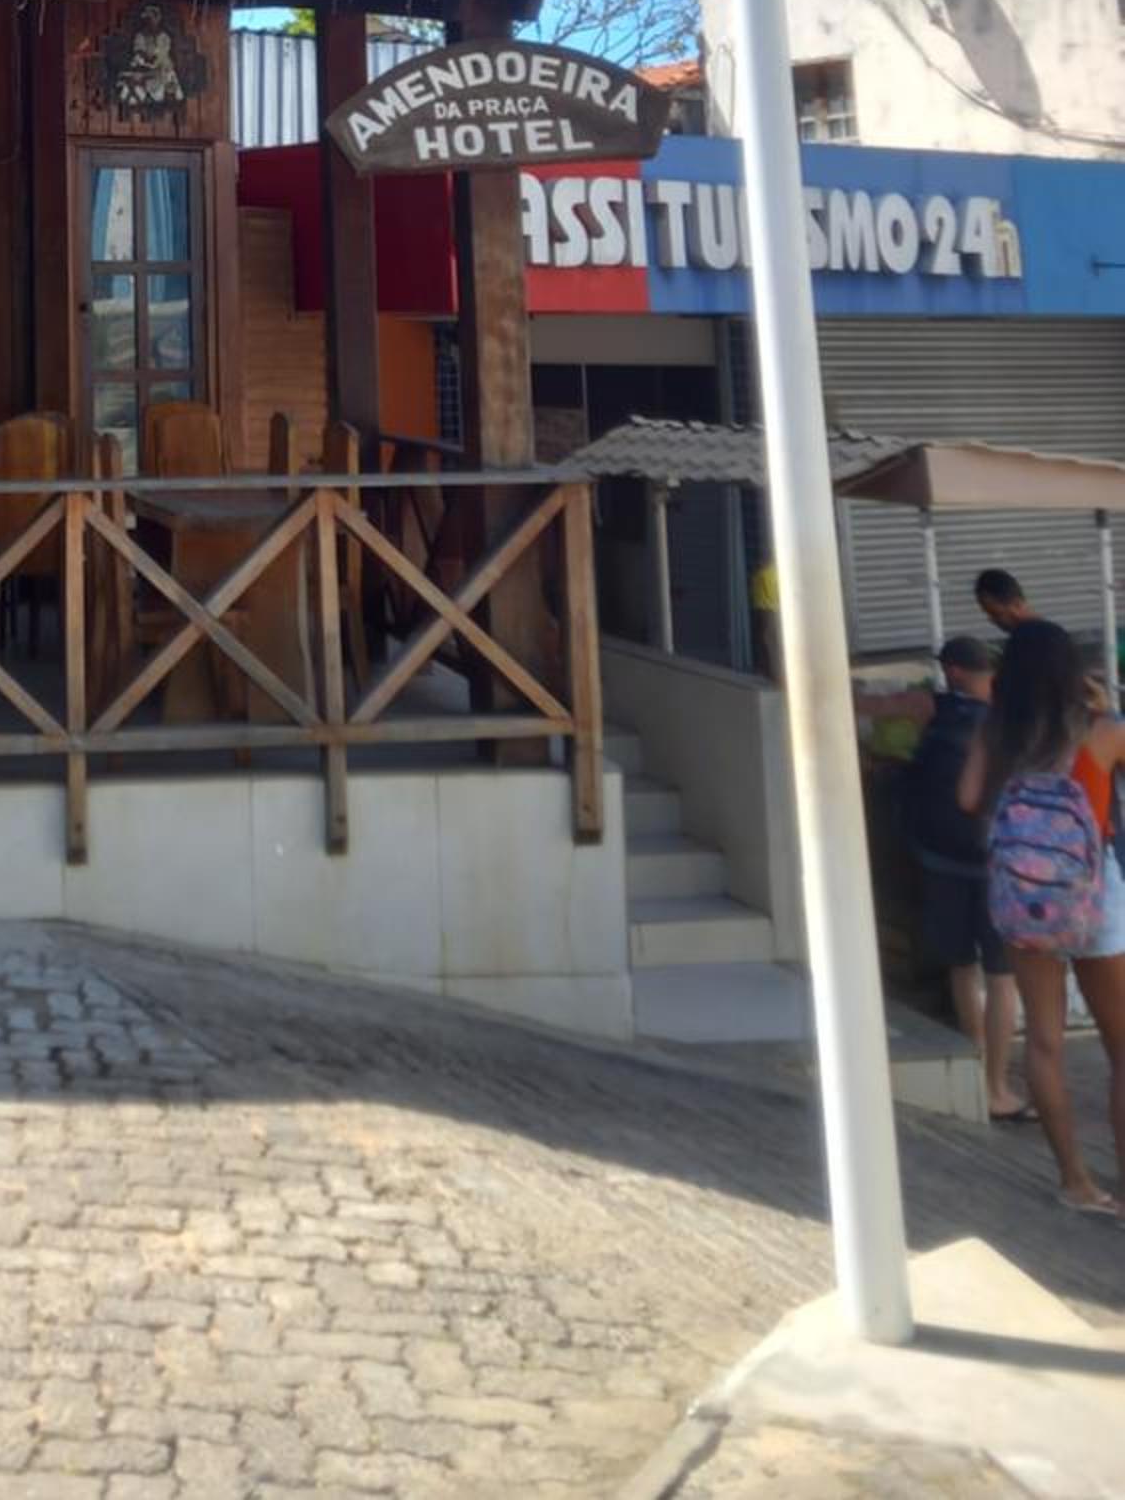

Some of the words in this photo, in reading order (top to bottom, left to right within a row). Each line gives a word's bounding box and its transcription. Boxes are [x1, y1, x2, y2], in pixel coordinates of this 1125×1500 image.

[347, 51, 638, 151] AMENDOEIRA
[434, 101, 462, 120] DA
[467, 96, 549, 117] PRAÇA
[414, 119, 594, 160] HOTEL
[657, 180, 919, 274] TUSMO
